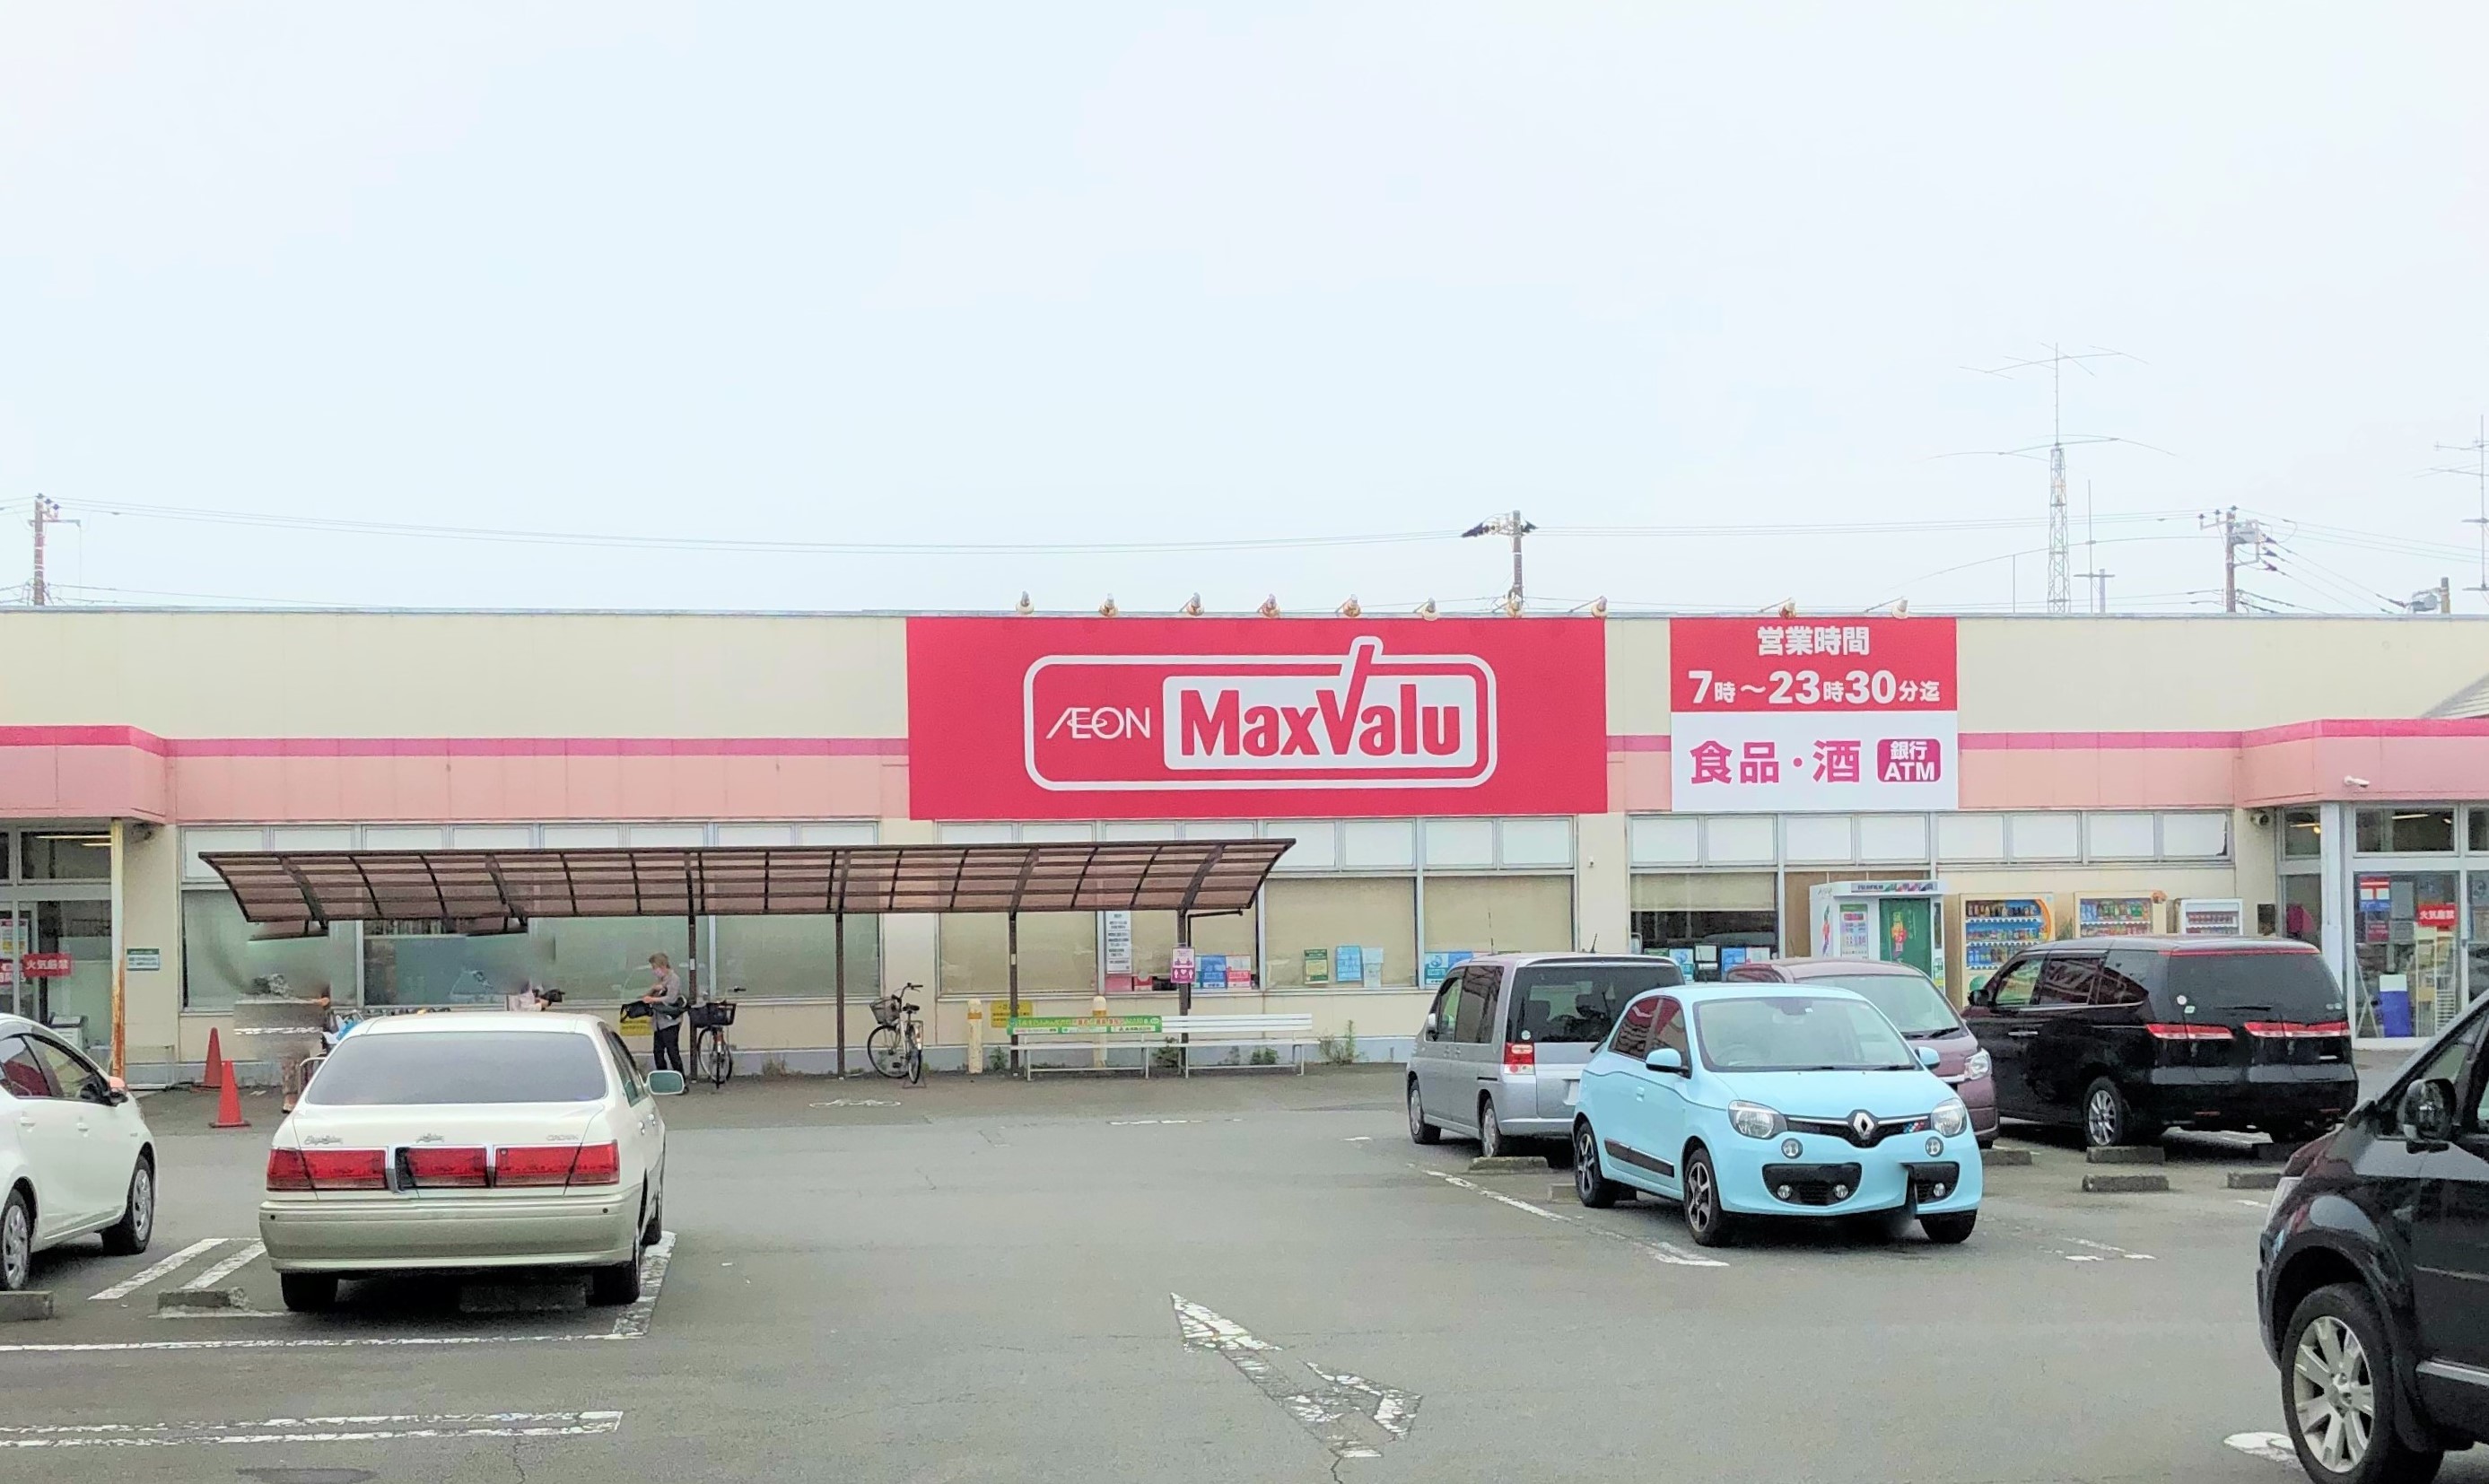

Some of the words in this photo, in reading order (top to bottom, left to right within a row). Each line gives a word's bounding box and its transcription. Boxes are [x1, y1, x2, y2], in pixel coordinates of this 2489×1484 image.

[1757, 625, 1870, 656] 営業時間
[1180, 645, 1461, 756] MaxValu
[1690, 740, 1862, 784] 食品・酒
[1890, 741, 1928, 761] 銀行
[1884, 762, 1935, 781] ATM
